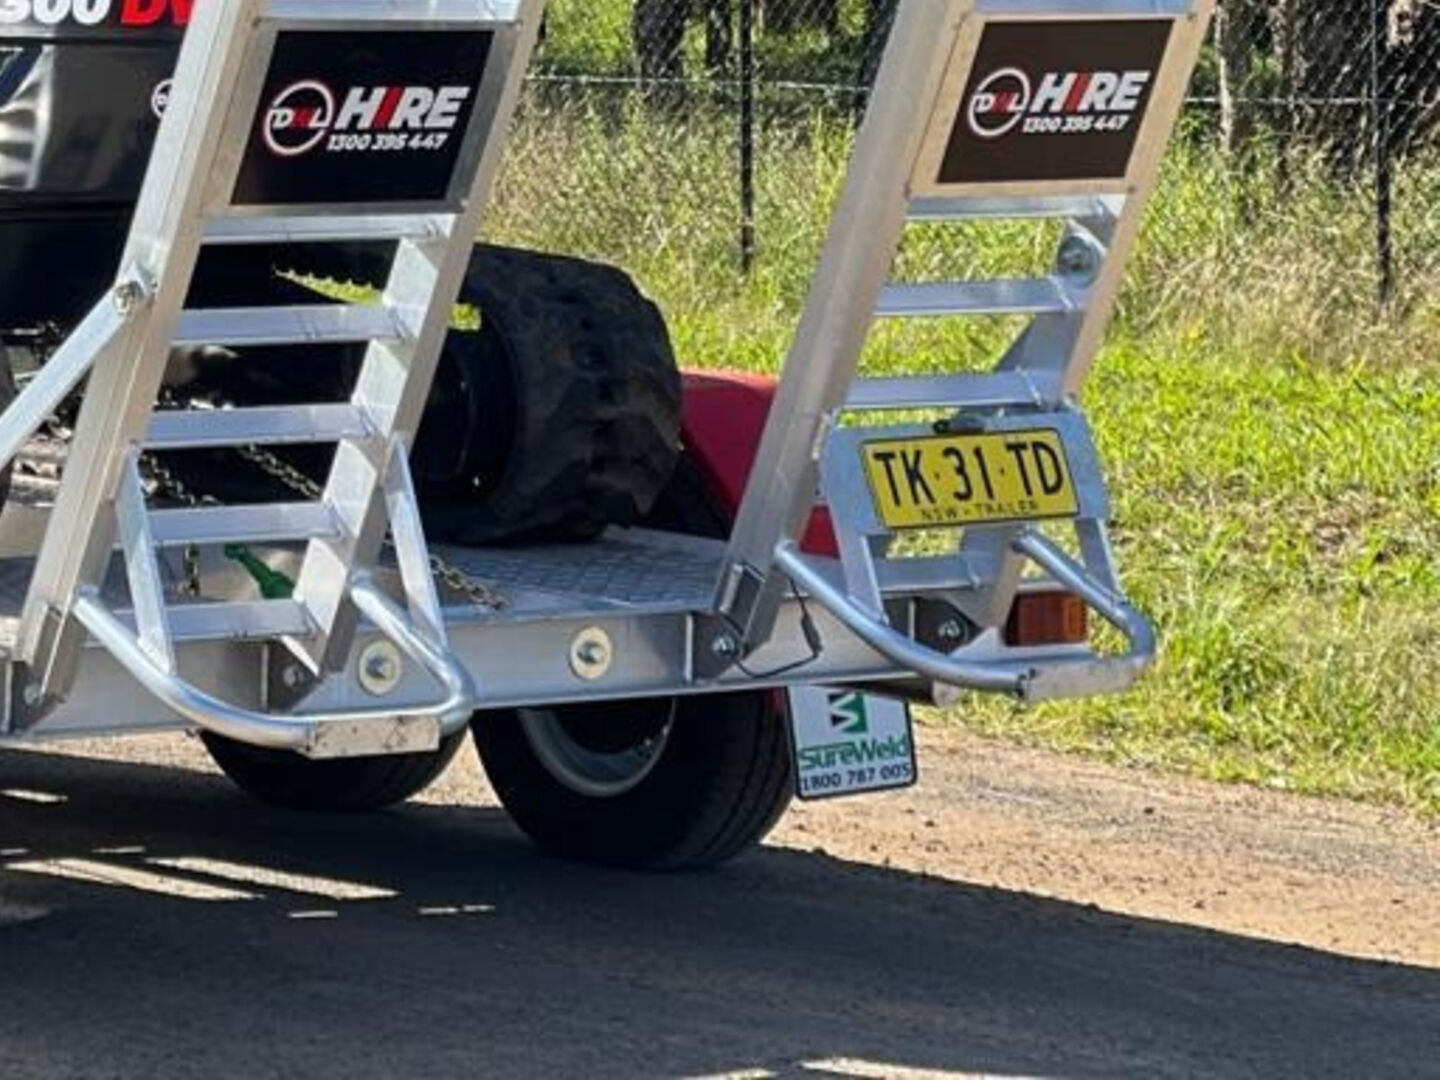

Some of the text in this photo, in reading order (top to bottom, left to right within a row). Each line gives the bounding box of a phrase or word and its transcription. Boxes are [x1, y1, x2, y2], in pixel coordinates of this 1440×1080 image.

[1029, 70, 1151, 114] HIRE
[334, 85, 471, 131] HIRE
[1022, 116, 1061, 133] 1300
[1095, 114, 1131, 131] 447
[326, 133, 371, 152] 1300
[408, 132, 448, 150] 447
[798, 734, 909, 770] SureWeld
[802, 772, 842, 791] 1800
[846, 767, 877, 785] 787
